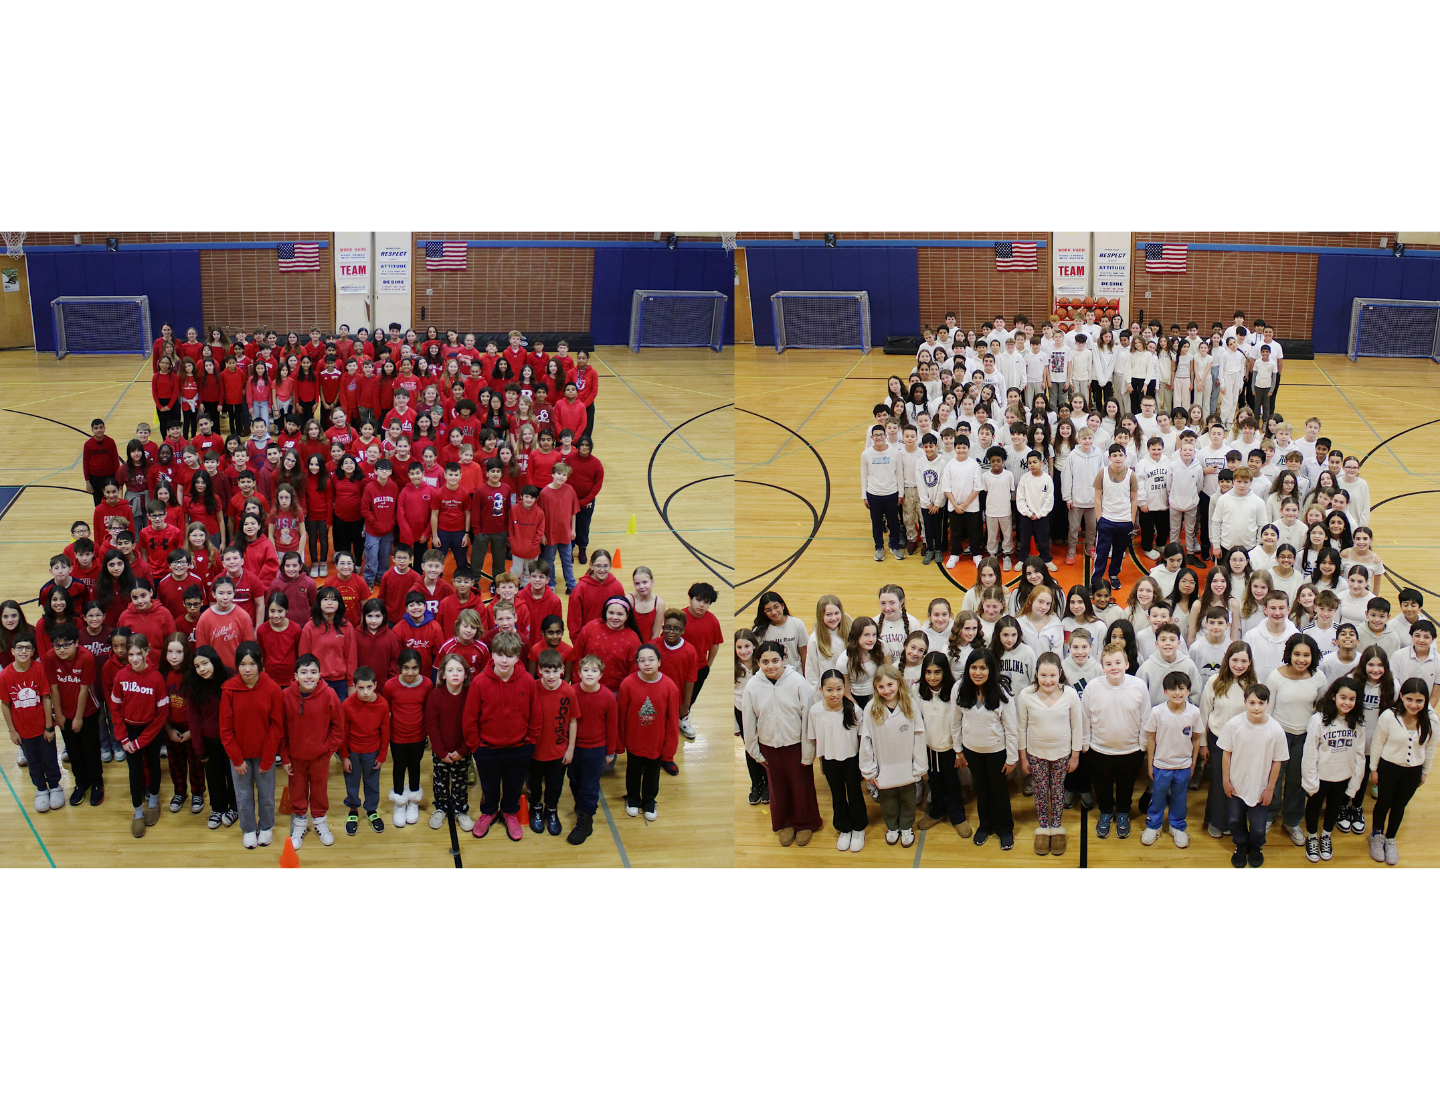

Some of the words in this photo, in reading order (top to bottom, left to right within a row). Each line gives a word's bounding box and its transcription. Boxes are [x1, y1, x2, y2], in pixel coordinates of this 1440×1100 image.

[340, 265, 366, 276] TEAM
[1058, 265, 1085, 276] TEAM
[425, 600, 439, 614] R
[92, 641, 104, 650] Dr
[1000, 658, 1024, 674] ROLINA
[119, 681, 153, 695] Wilson
[1363, 693, 1379, 704] LITE
[555, 697, 570, 745] adidas
